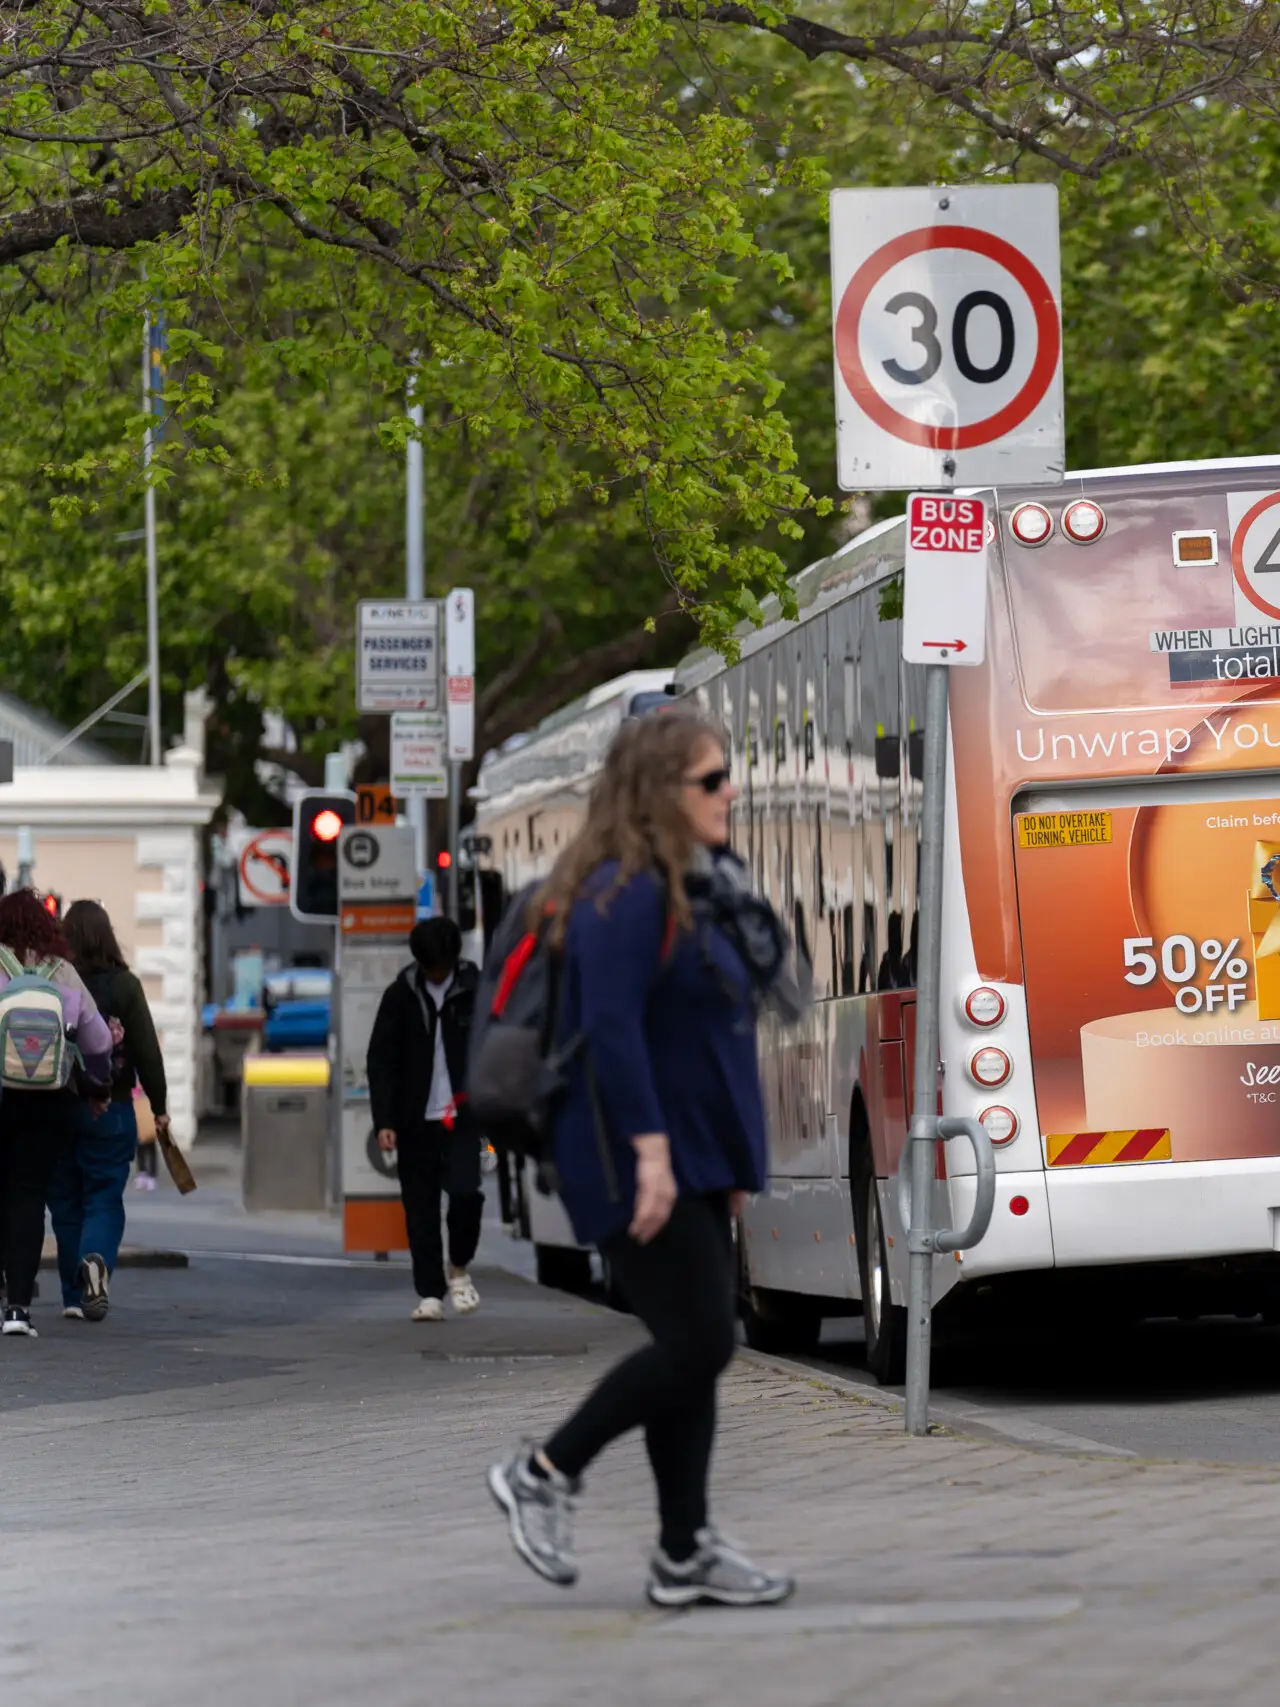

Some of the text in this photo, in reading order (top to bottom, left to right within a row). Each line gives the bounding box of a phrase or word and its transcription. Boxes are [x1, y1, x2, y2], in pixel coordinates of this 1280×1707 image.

[881, 290, 1015, 385] 30
[921, 500, 974, 523] BUS
[911, 526, 982, 550] ZONE
[364, 636, 433, 651] PASSENGER
[1154, 630, 1212, 650] WHEN
[369, 656, 427, 672] SERVICES
[1212, 647, 1279, 680] total
[1016, 726, 1191, 763] Unwrap
[360, 792, 394, 822] D4
[1023, 812, 1107, 831] DO NOT OVERTAKE
[1206, 815, 1249, 829] Claim
[1025, 830, 1066, 845] TURNING
[1123, 934, 1248, 986] 50%
[1175, 983, 1247, 1013] OFF
[1135, 1029, 1190, 1048] Book
[1193, 1025, 1255, 1044] online
